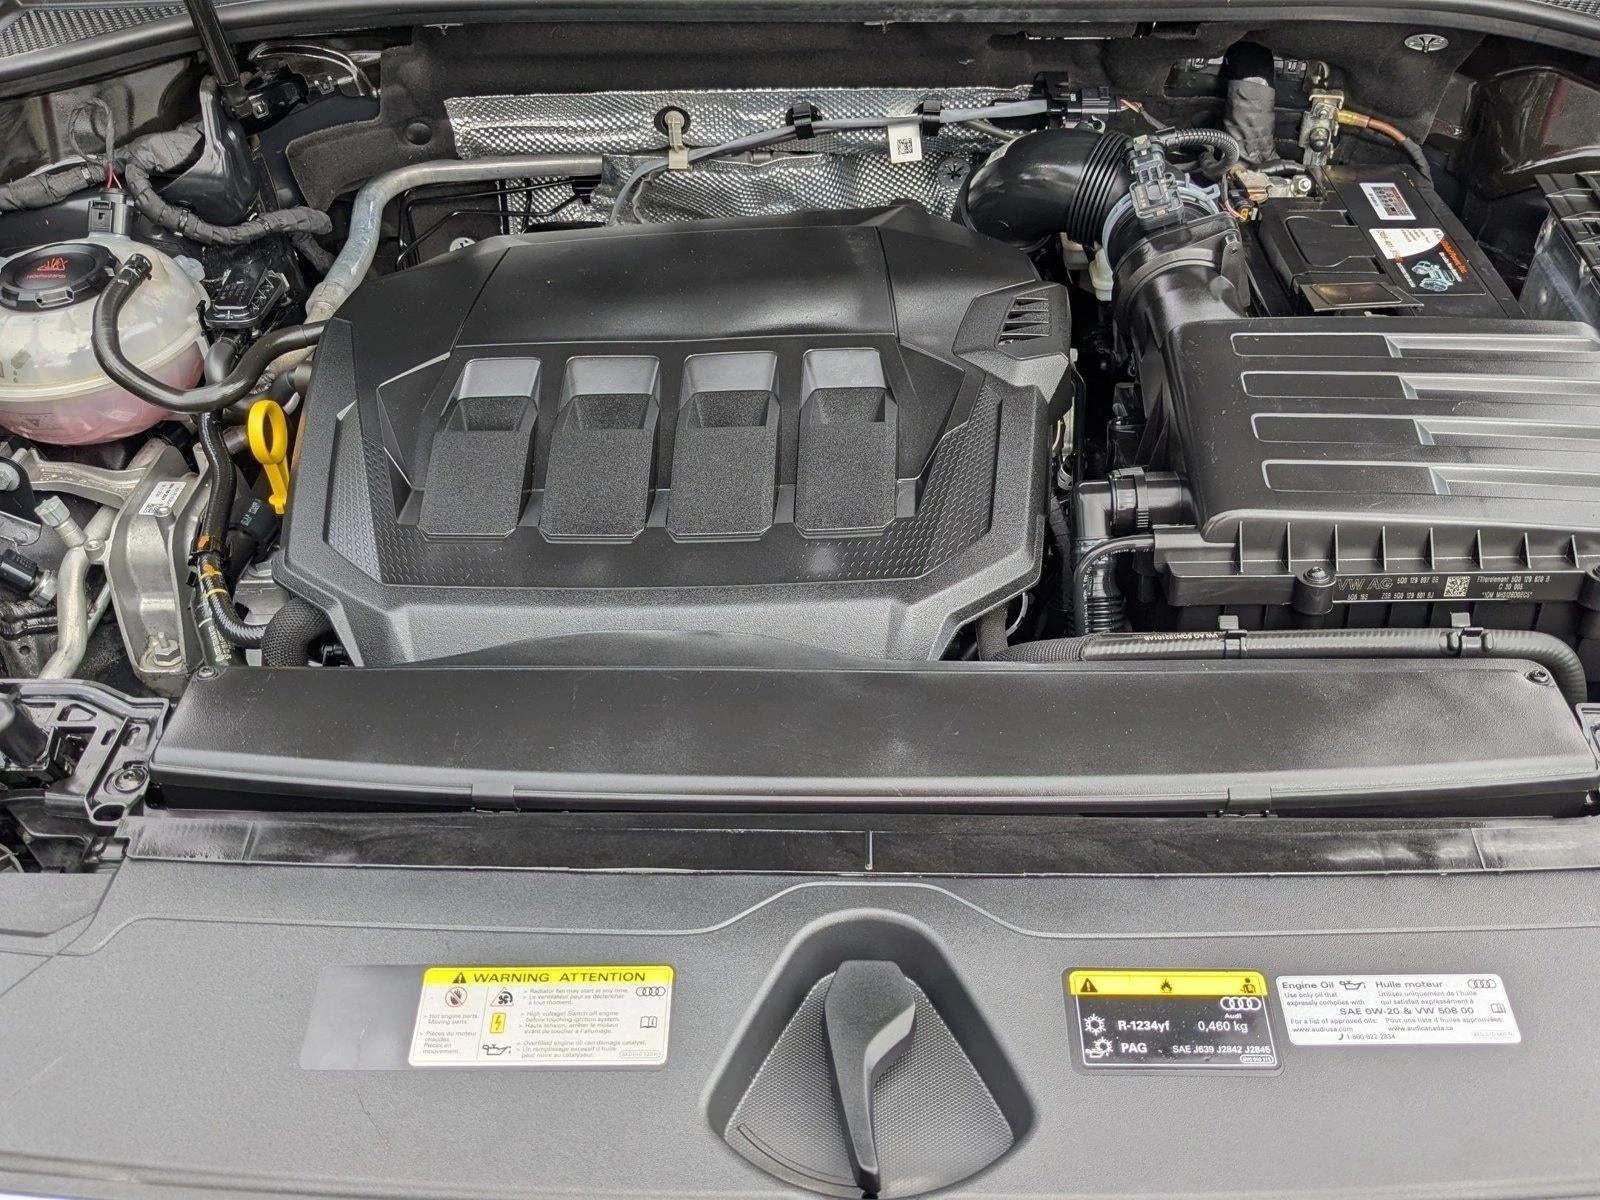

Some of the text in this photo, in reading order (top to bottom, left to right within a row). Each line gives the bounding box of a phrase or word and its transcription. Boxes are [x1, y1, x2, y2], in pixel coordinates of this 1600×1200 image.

[1338, 577, 1393, 590] VW AG
[474, 971, 646, 983] WARNING ATTENTION
[1282, 981, 1334, 990] Engine Oil
[1404, 990, 1445, 998] uniquement
[1340, 1007, 1362, 1015] SAE
[1365, 1007, 1400, 1015] 0W-20
[1117, 1020, 1249, 1033] R-1234yf 0,460 kg
[1121, 1042, 1148, 1054] PAG
[1172, 1045, 1272, 1054] SAE J639 J2842 J2845
